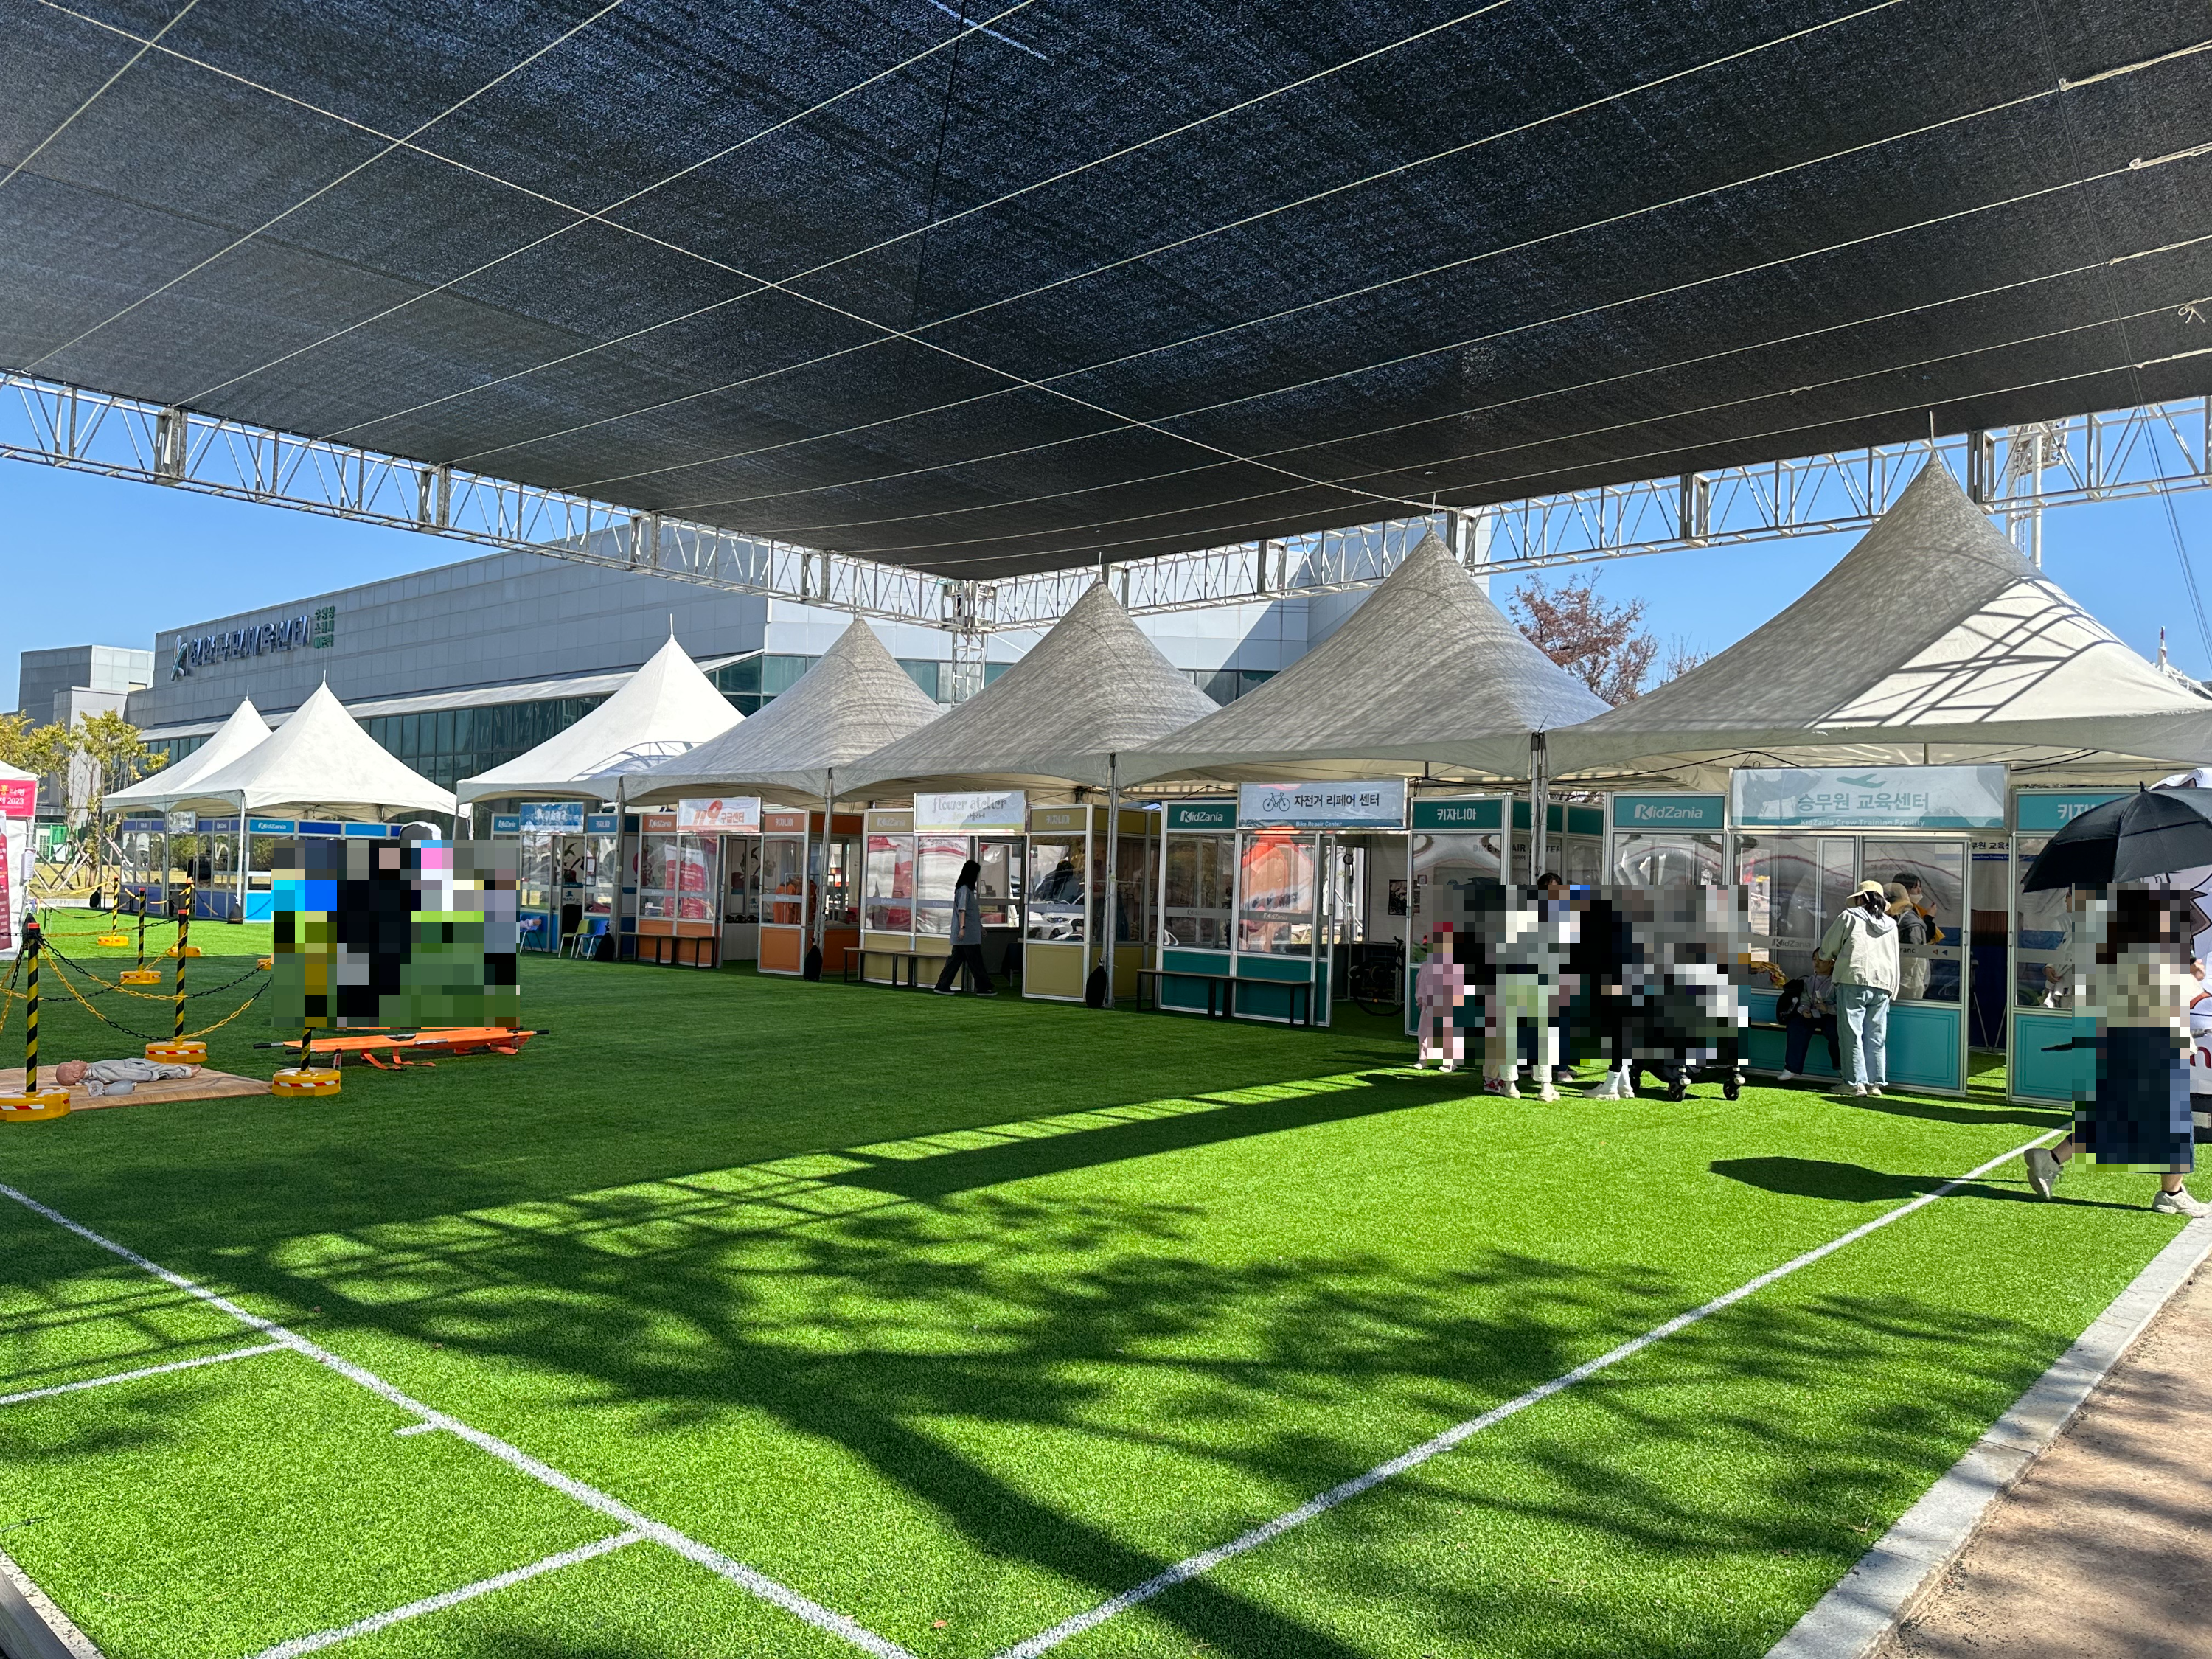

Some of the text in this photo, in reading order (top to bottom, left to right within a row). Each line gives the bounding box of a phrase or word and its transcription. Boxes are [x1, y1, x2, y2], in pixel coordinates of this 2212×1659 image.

[7, 797, 24, 805] 2023
[932, 796, 1007, 813] flower atelier
[1294, 793, 1380, 807] 자전거 리페어 센터
[1798, 793, 1929, 811] 승무원 교육센터
[693, 799, 723, 824] 119
[720, 812, 745, 824] 구급센터
[1180, 810, 1223, 823] KidZania
[1437, 808, 1477, 821] 키자니아
[1634, 804, 1703, 820] KidZania
[877, 817, 906, 827] KidZania
[1046, 815, 1070, 825] 키자니아
[1859, 819, 1893, 827] Training
[1894, 819, 1925, 827] Facility
[1771, 938, 1812, 948] KidZania
